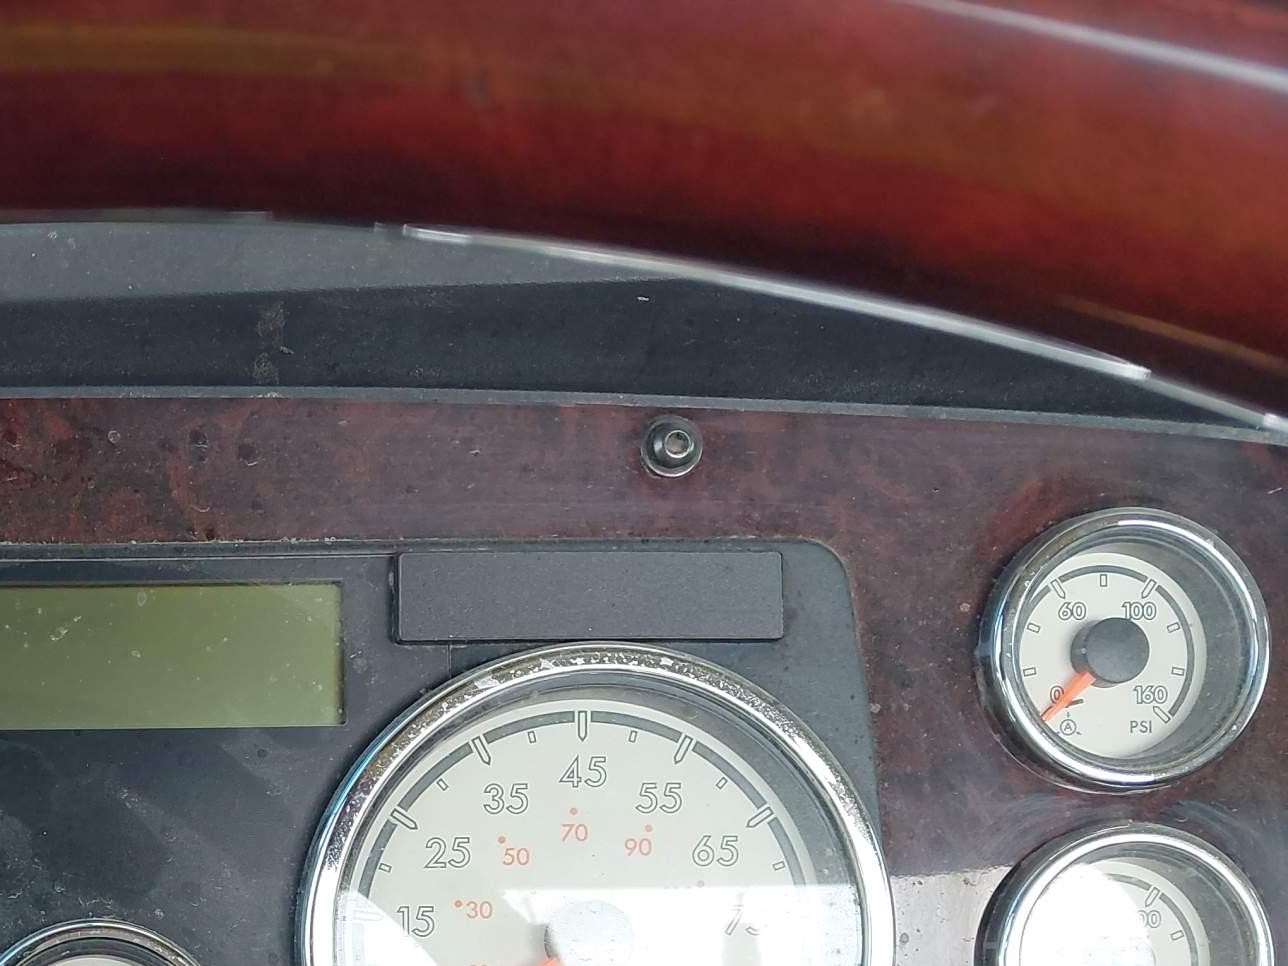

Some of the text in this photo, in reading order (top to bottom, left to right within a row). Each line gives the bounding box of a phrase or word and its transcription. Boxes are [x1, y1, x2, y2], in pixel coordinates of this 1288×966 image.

[1058, 602, 1086, 620] 60
[1122, 602, 1156, 620] 100
[1134, 685, 1167, 704] 160
[1130, 721, 1152, 734] PSI
[560, 755, 607, 788] 45
[483, 783, 529, 815] 35
[635, 782, 682, 814] 55
[561, 823, 588, 842] 70
[424, 838, 471, 869] 25
[502, 847, 530, 866] 50
[624, 838, 652, 857] 90
[692, 835, 739, 867] 65
[466, 901, 492, 919] 30
[396, 906, 436, 938] 15
